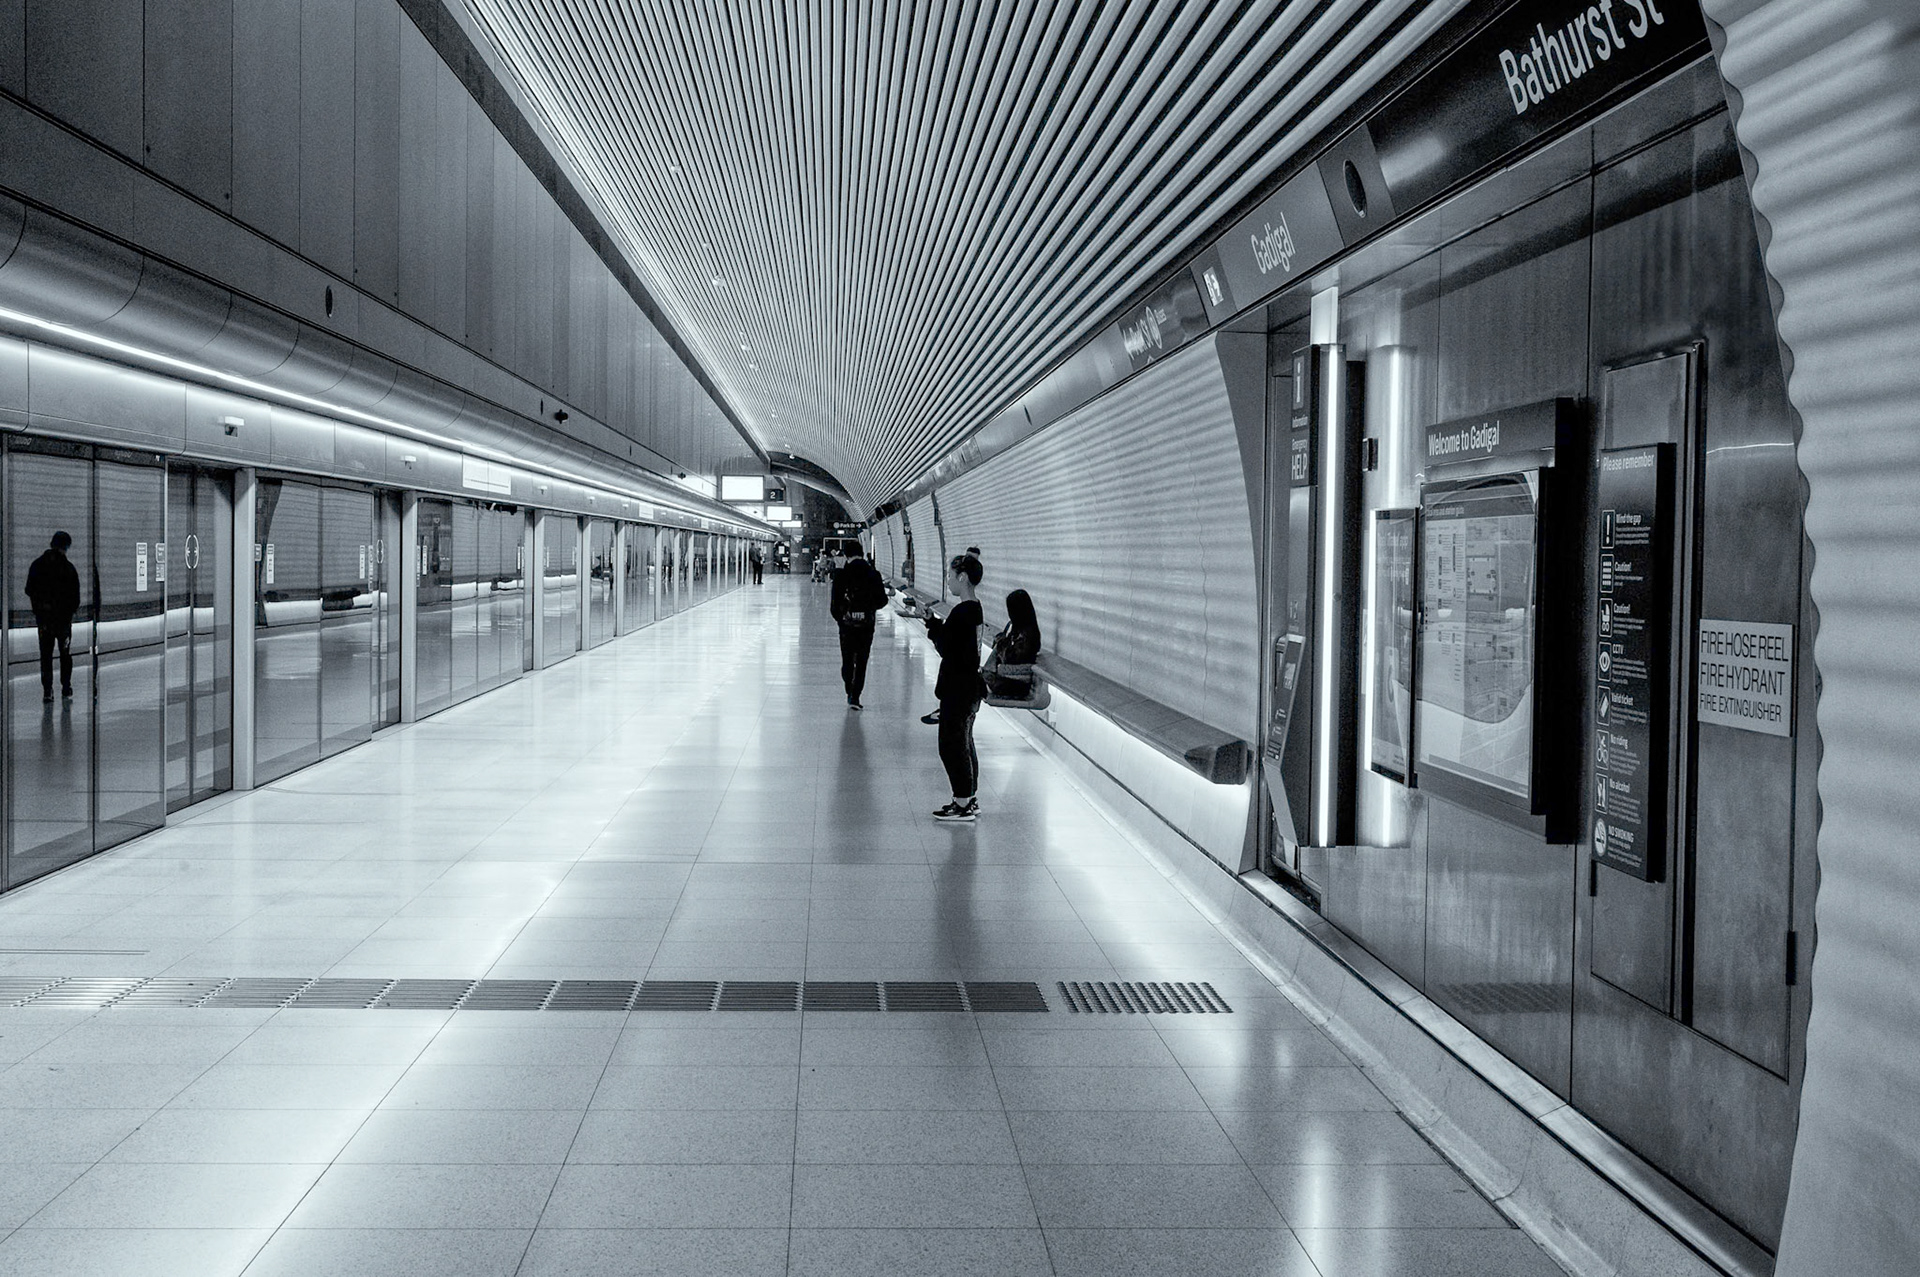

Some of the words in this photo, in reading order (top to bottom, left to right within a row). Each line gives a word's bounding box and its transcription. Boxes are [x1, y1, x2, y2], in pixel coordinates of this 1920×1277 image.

[1499, 0, 1626, 115] Bathurst
[1250, 211, 1297, 275] Gadigal
[1428, 432, 1460, 457] Welcome
[1460, 429, 1470, 454] to
[1470, 420, 1500, 453] Gadigal
[1291, 452, 1307, 481] HELP
[1603, 456, 1622, 471] Please
[1622, 451, 1655, 470] remember
[769, 491, 776, 499] 2
[851, 611, 865, 620] UTS
[1701, 630, 1724, 655] FIRE
[1725, 632, 1757, 659] HOSE
[1758, 635, 1789, 662] REEL
[1700, 662, 1725, 688] FIRE
[1725, 664, 1785, 696] HYDRANT
[1699, 692, 1717, 712] FIRE
[1718, 695, 1782, 723] EXTINGUISHER
[1608, 825, 1615, 836] NO
[1614, 827, 1634, 843] SMOKING
